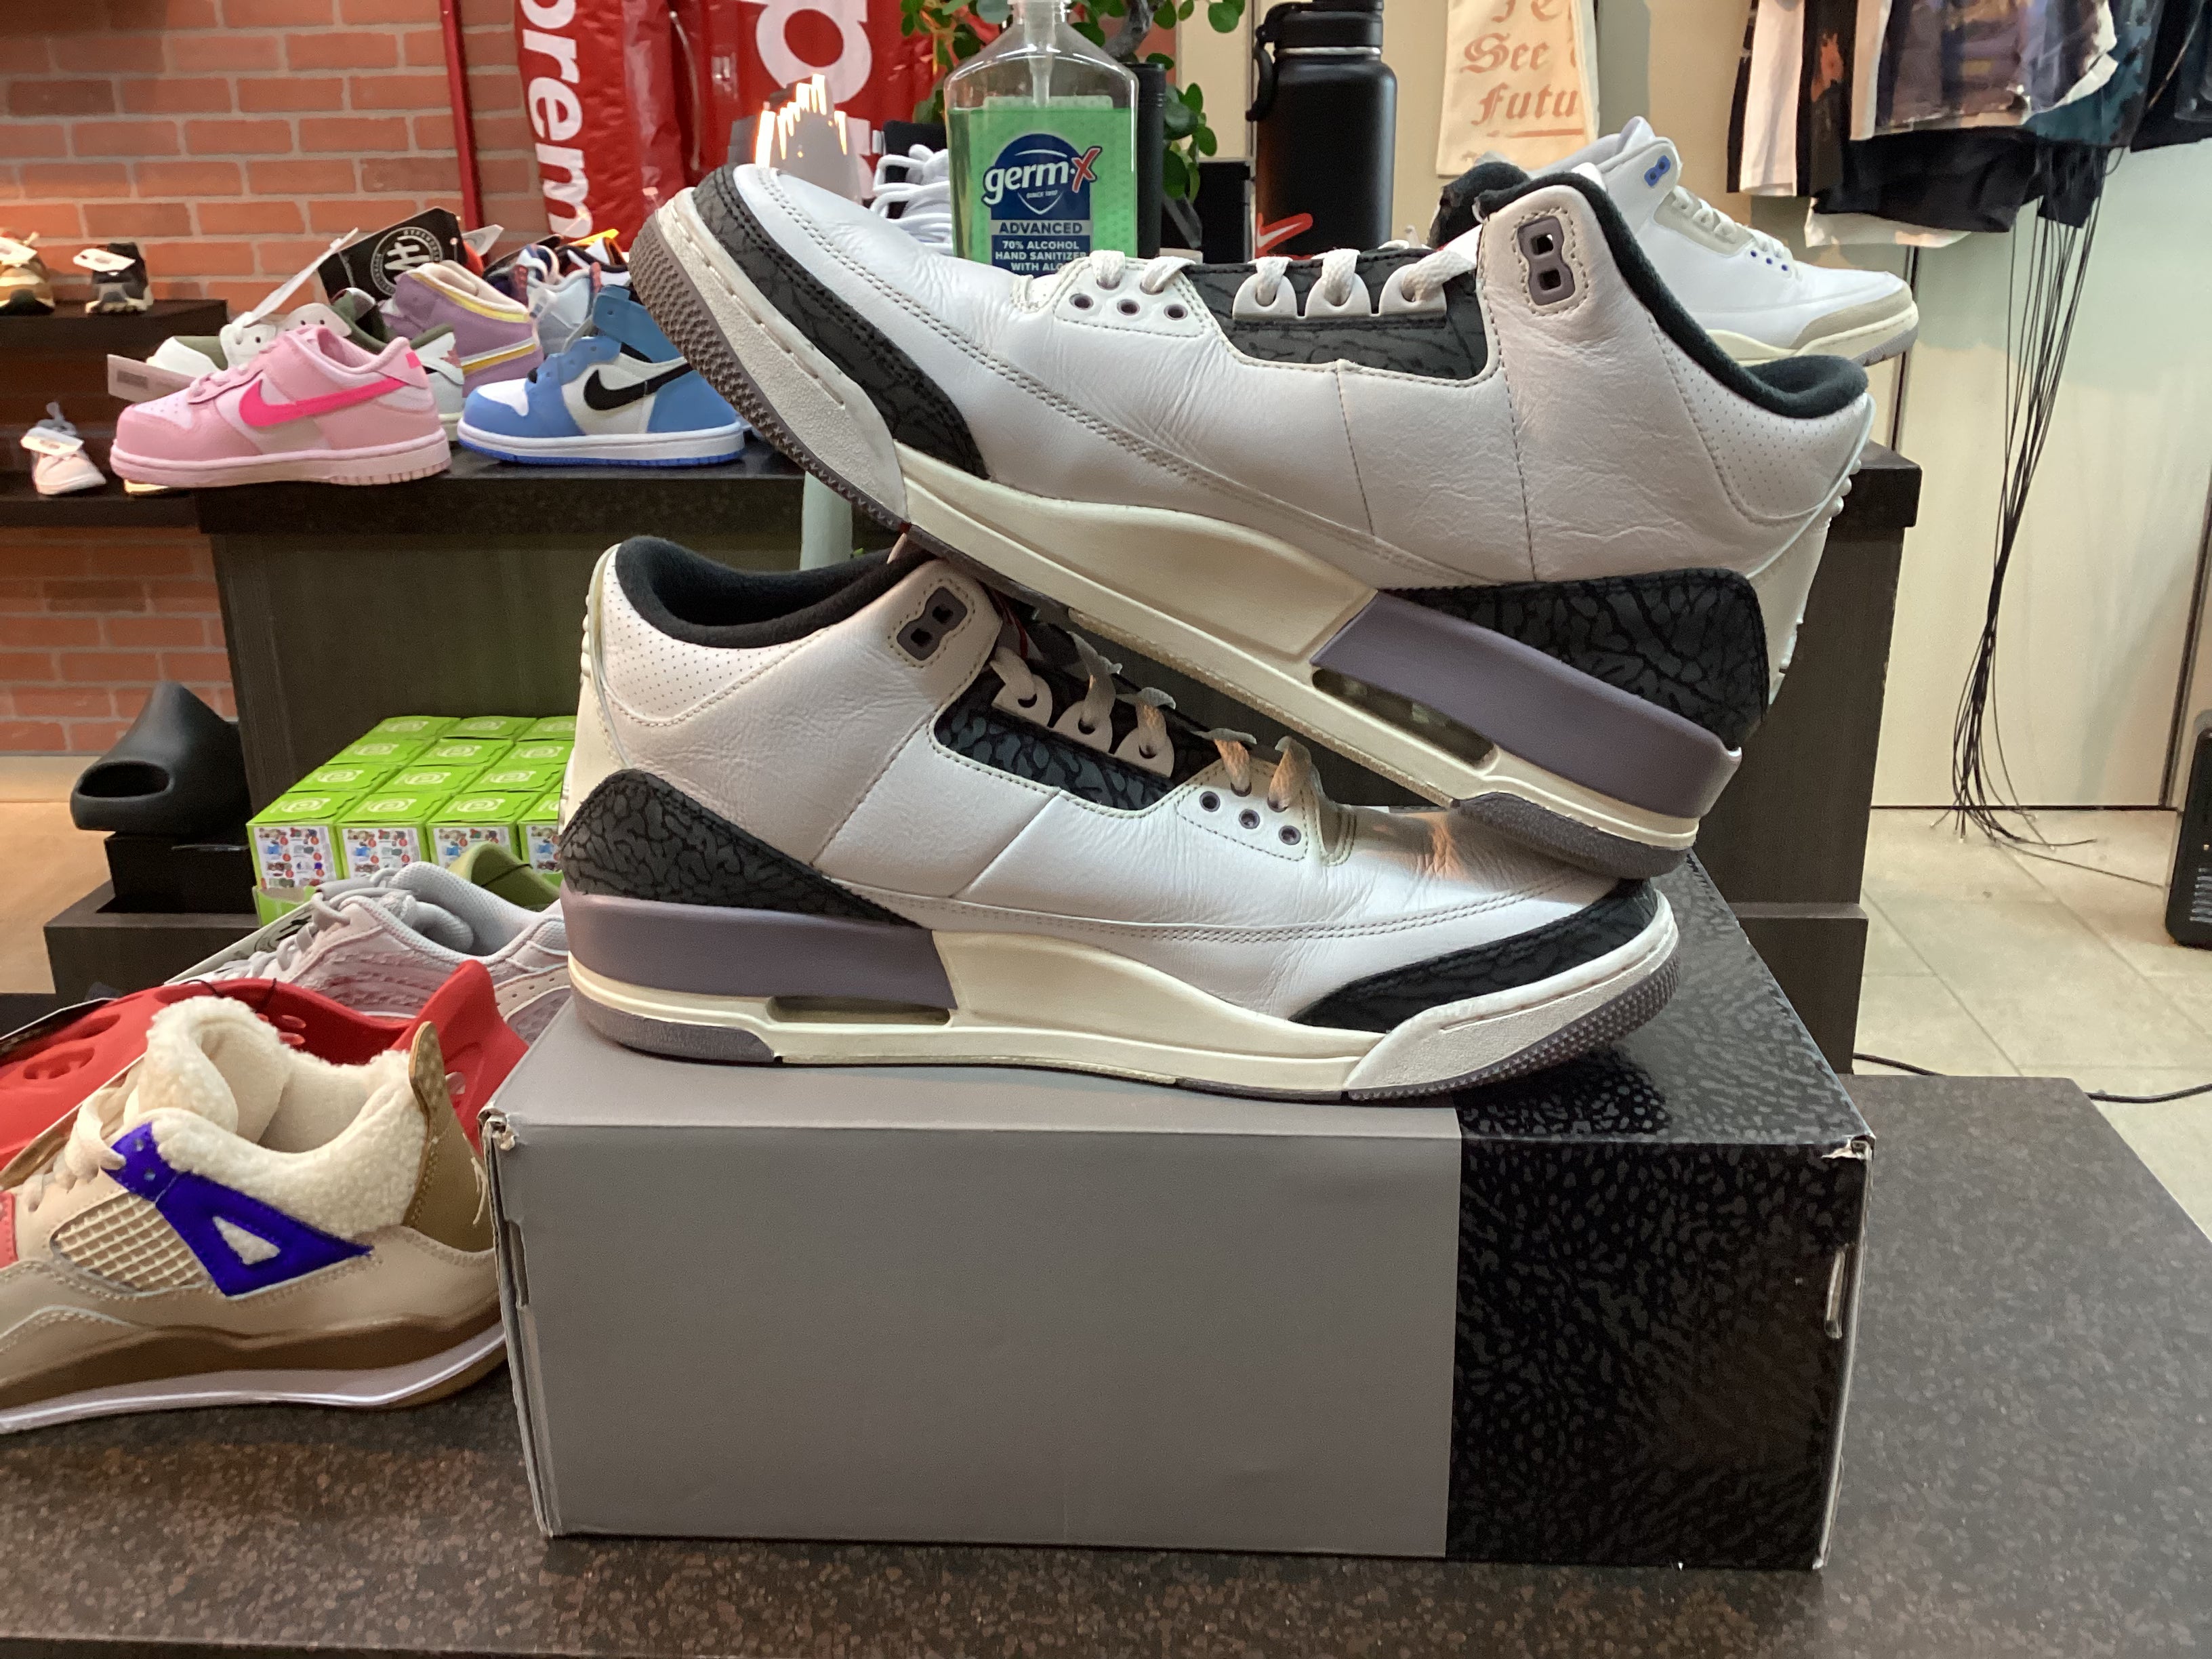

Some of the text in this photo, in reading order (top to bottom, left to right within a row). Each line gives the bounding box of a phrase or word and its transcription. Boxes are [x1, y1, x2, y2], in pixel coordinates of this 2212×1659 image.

[1000, 222, 1083, 234] ADVANCED
[1002, 240, 1080, 250] 70% ALCOHOL
[995, 251, 1027, 260] HAND
[1010, 262, 1040, 271] WITH
